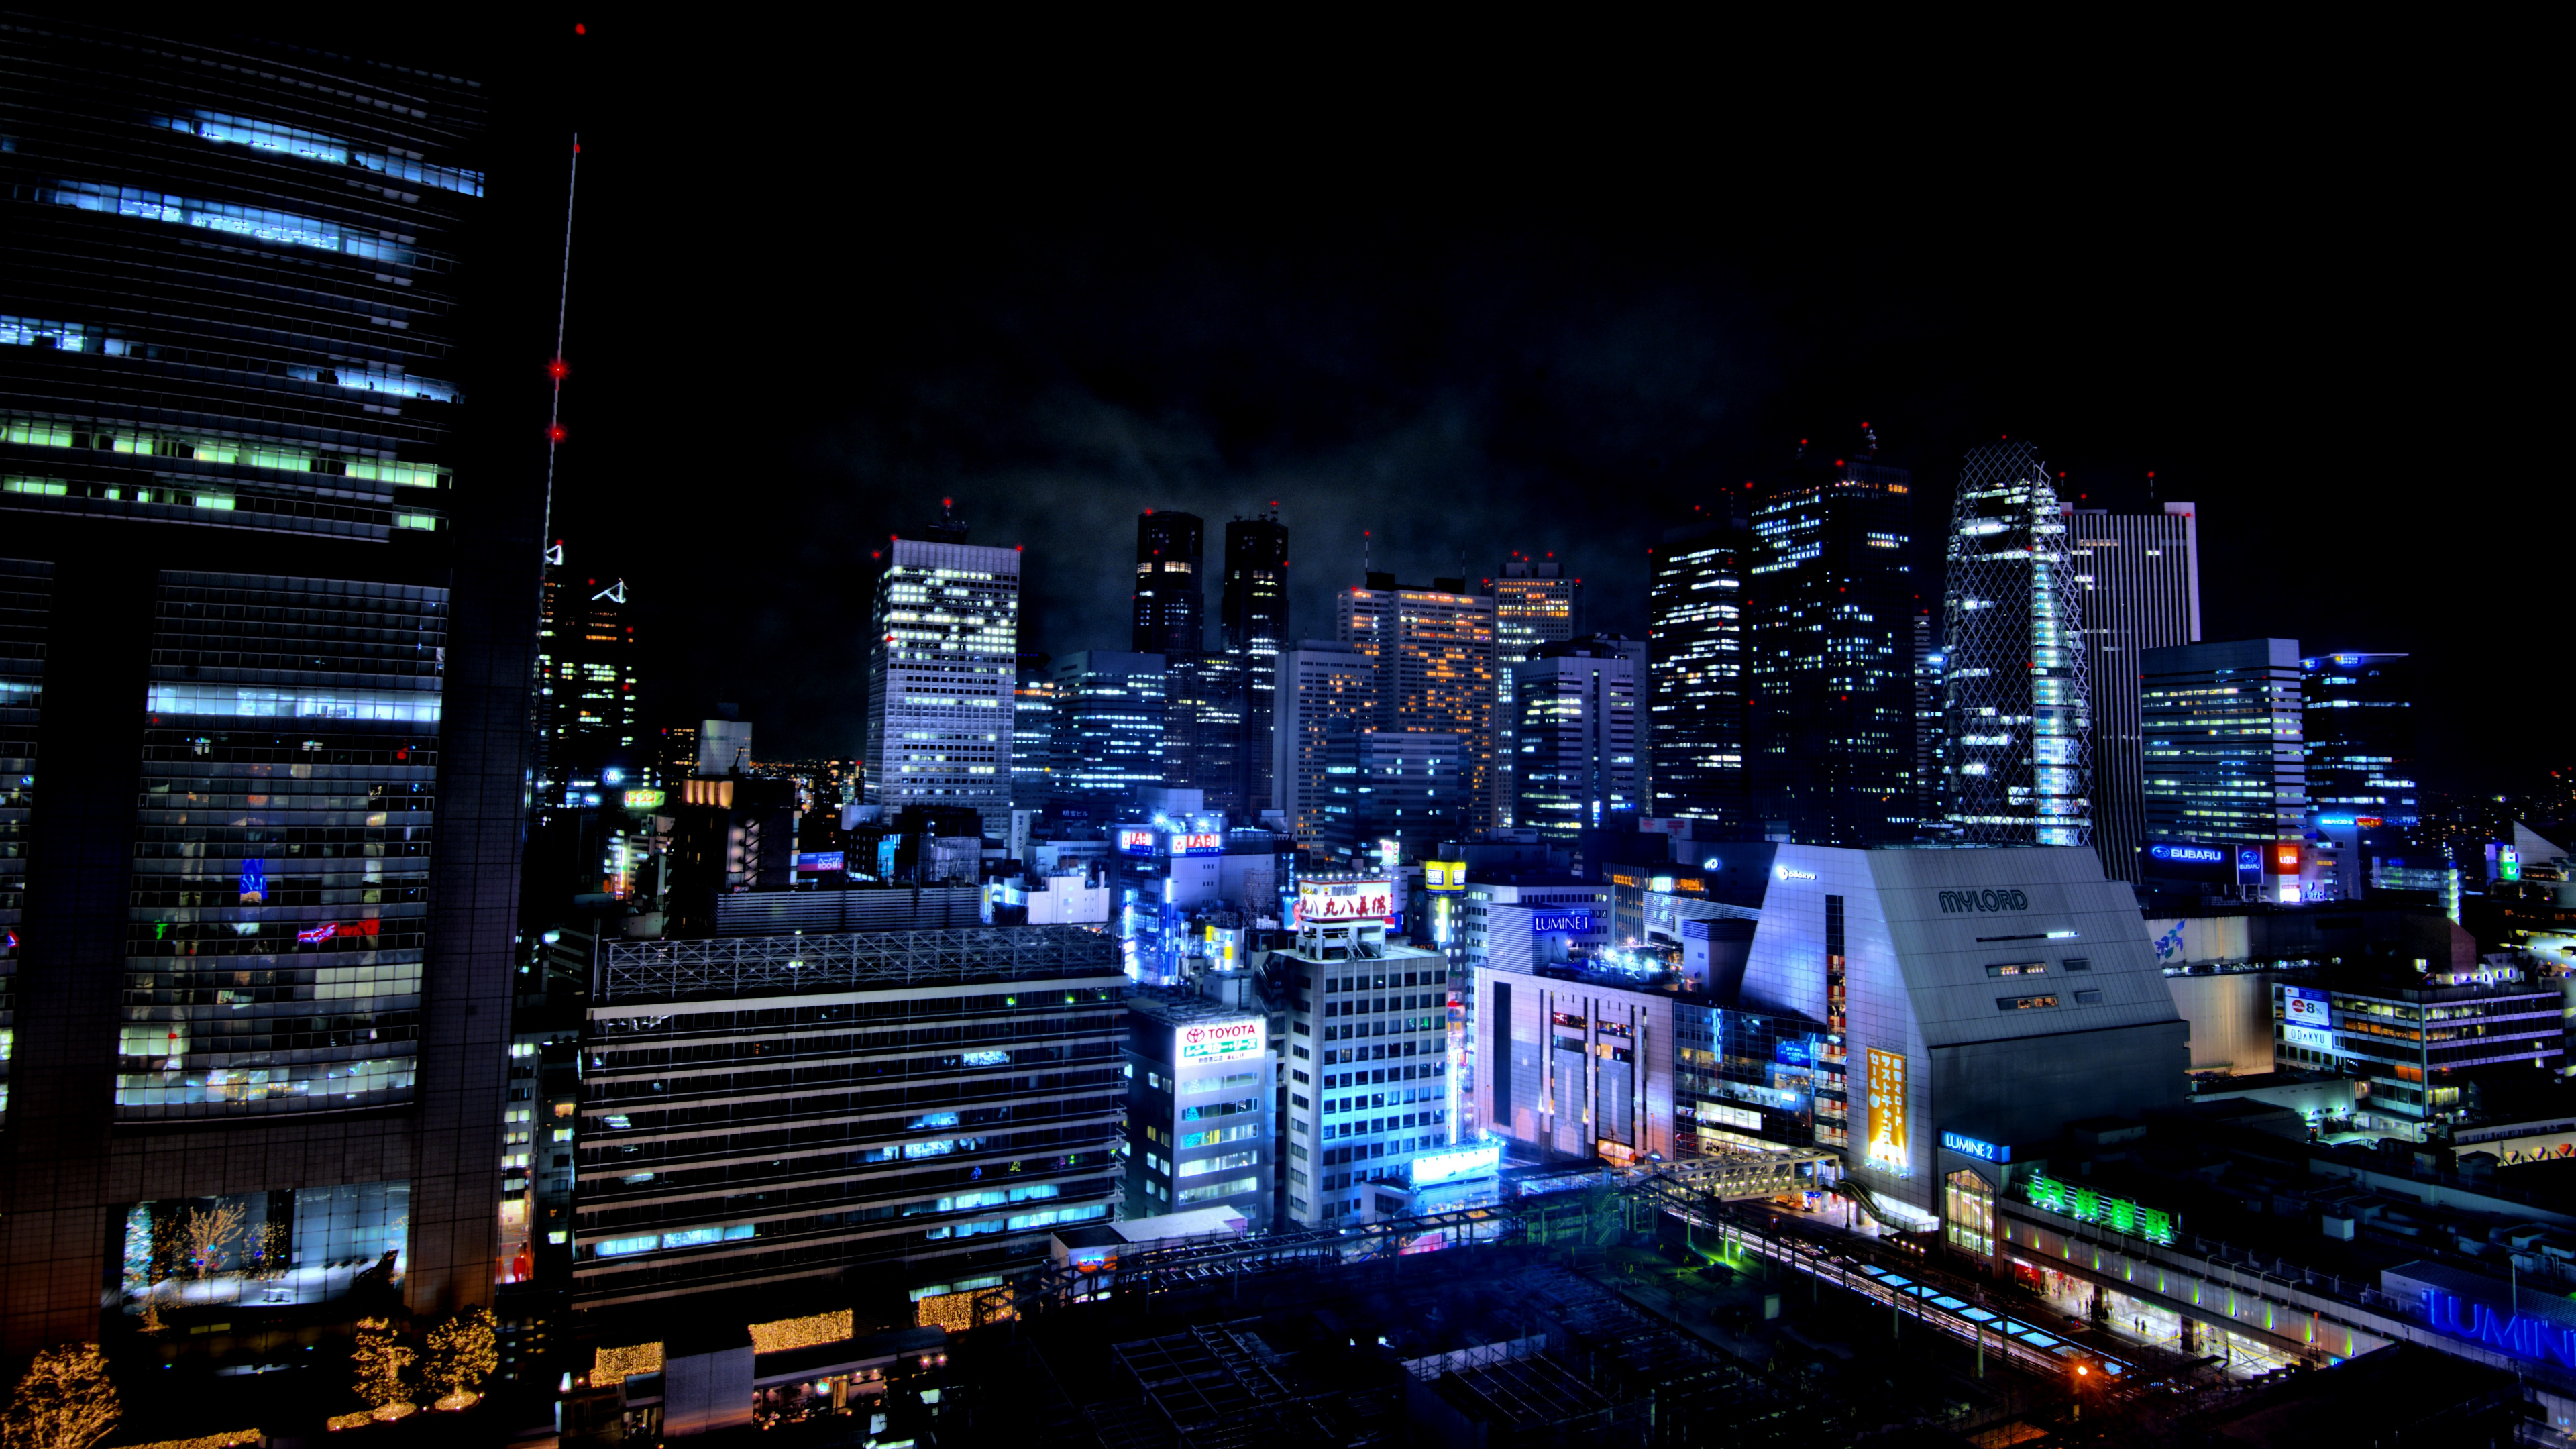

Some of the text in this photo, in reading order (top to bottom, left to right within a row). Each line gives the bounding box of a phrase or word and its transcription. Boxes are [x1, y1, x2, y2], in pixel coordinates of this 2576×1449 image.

[1130, 832, 1149, 845] LABI
[1186, 834, 1216, 848] LABI
[2171, 848, 2222, 861] SUBARU
[2279, 855, 2297, 864] LIXIL
[1939, 888, 2029, 914] MYLORD
[1536, 916, 1581, 930] LUMINE
[1208, 1024, 1256, 1040] TOYOTA
[2291, 1028, 2324, 1044] ODAKYU
[1185, 1038, 1257, 1057] レンタカー・リース
[1869, 1052, 1880, 1090] セール
[1881, 1055, 1892, 1144] ラストチャンス
[1946, 1134, 1993, 1159] LUMINE 2
[2029, 1177, 2171, 1240] JR新宿駅
